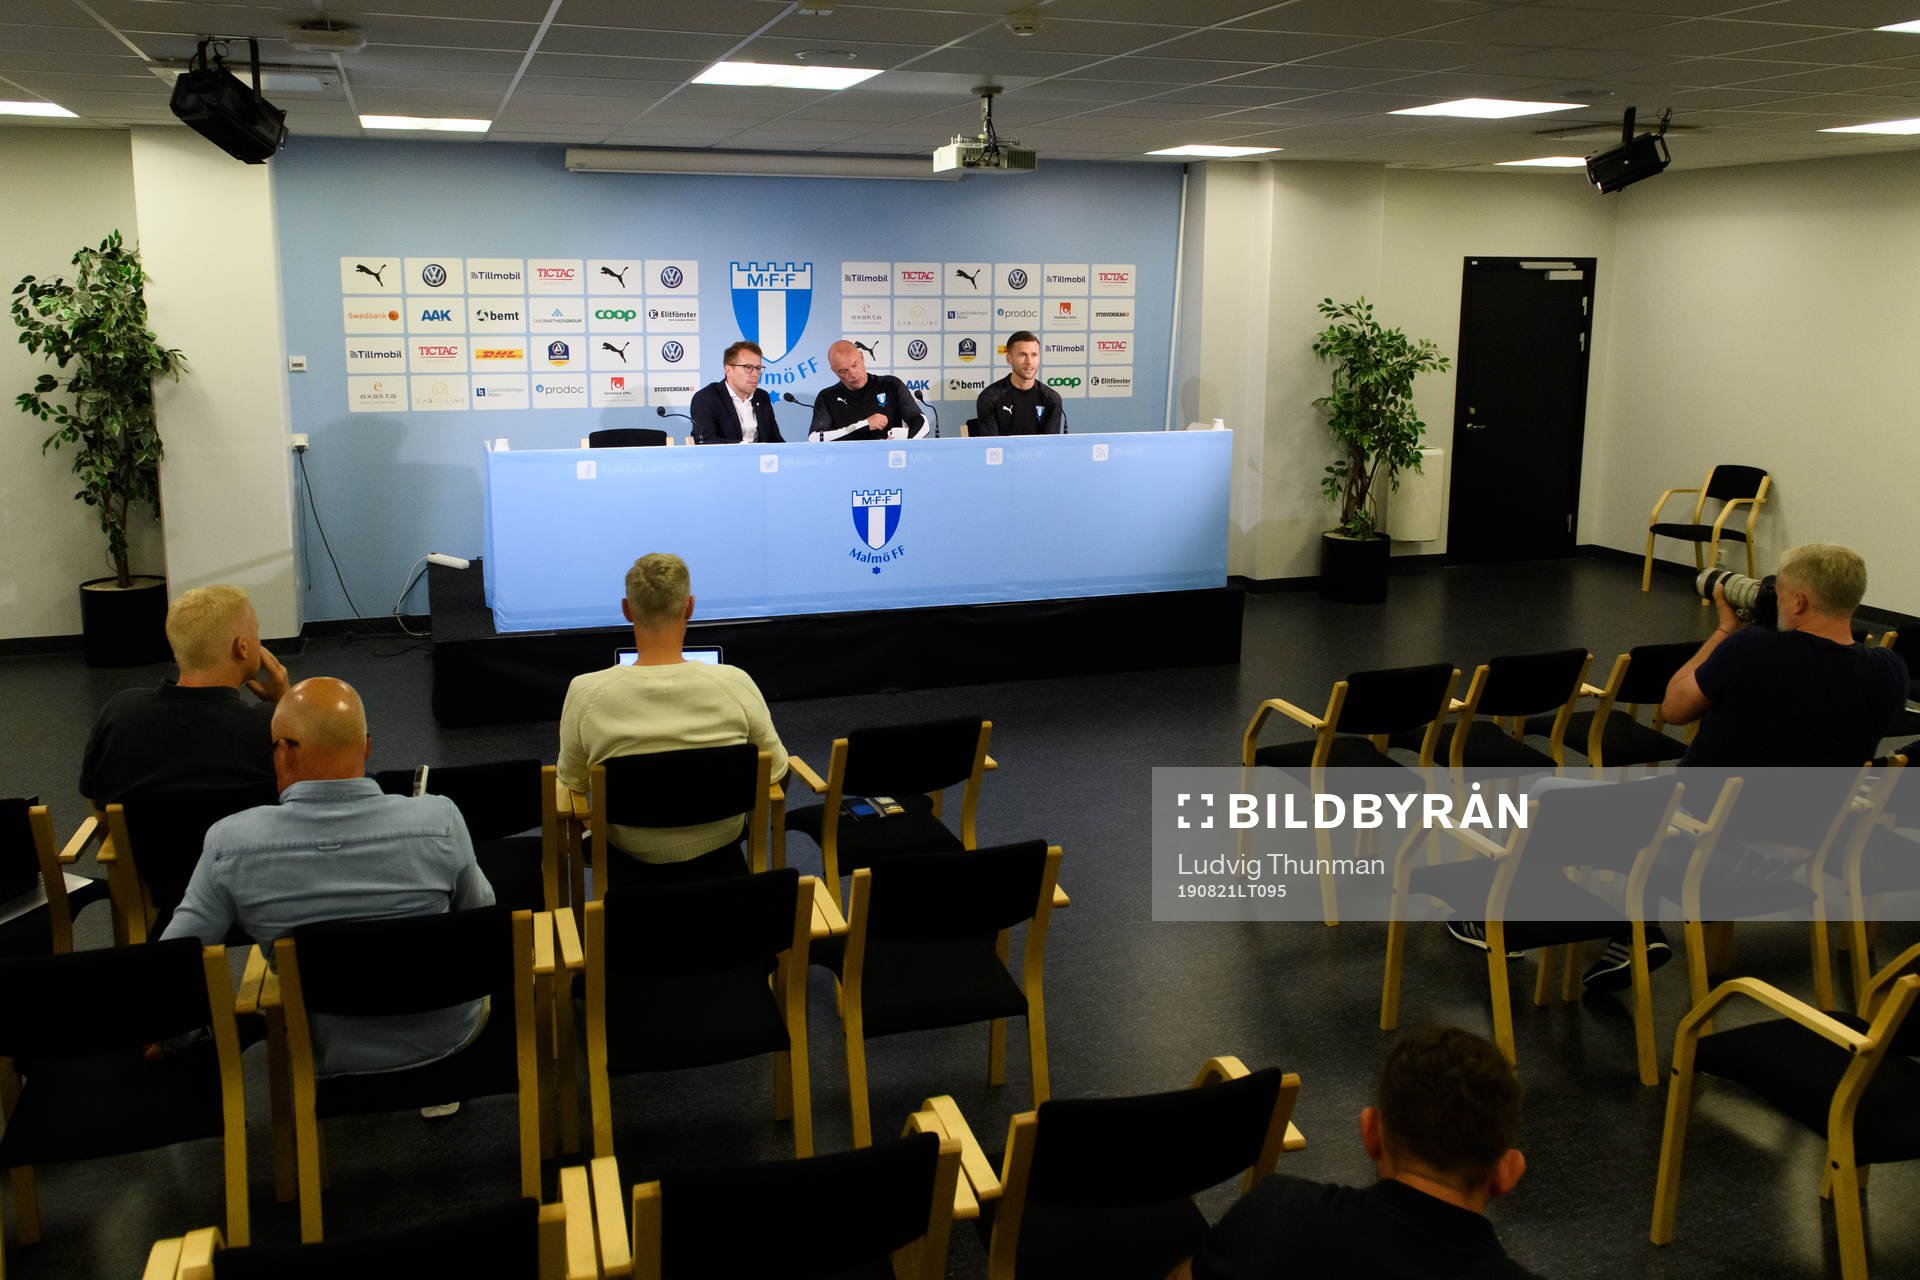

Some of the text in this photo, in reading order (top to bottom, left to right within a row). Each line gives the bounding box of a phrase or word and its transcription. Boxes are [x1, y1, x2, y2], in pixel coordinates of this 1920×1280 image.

[478, 271, 520, 280] Tillmobil
[537, 268, 575, 278] TICTAC
[901, 271, 934, 280] TICTAC
[1098, 272, 1128, 281] TICTAC
[851, 274, 888, 282] Tillmobil
[1052, 275, 1086, 283] Tillmobil
[348, 312, 387, 320] Swedbank
[421, 310, 452, 321] AAK
[490, 310, 519, 321] bemt
[595, 310, 636, 322] coop
[1005, 309, 1038, 321] prodoc
[1051, 344, 1085, 352] Tillmobil
[1097, 341, 1127, 350] TICTAC
[358, 350, 402, 359] Tillmobil
[418, 346, 458, 356] TICTAC
[482, 350, 516, 358] DHL
[797, 356, 819, 379] FF
[906, 380, 930, 390] AAK
[961, 380, 985, 389] bemt
[1047, 377, 1082, 388] coop
[545, 385, 584, 398] prodoc
[848, 545, 905, 564] Malmö FF
